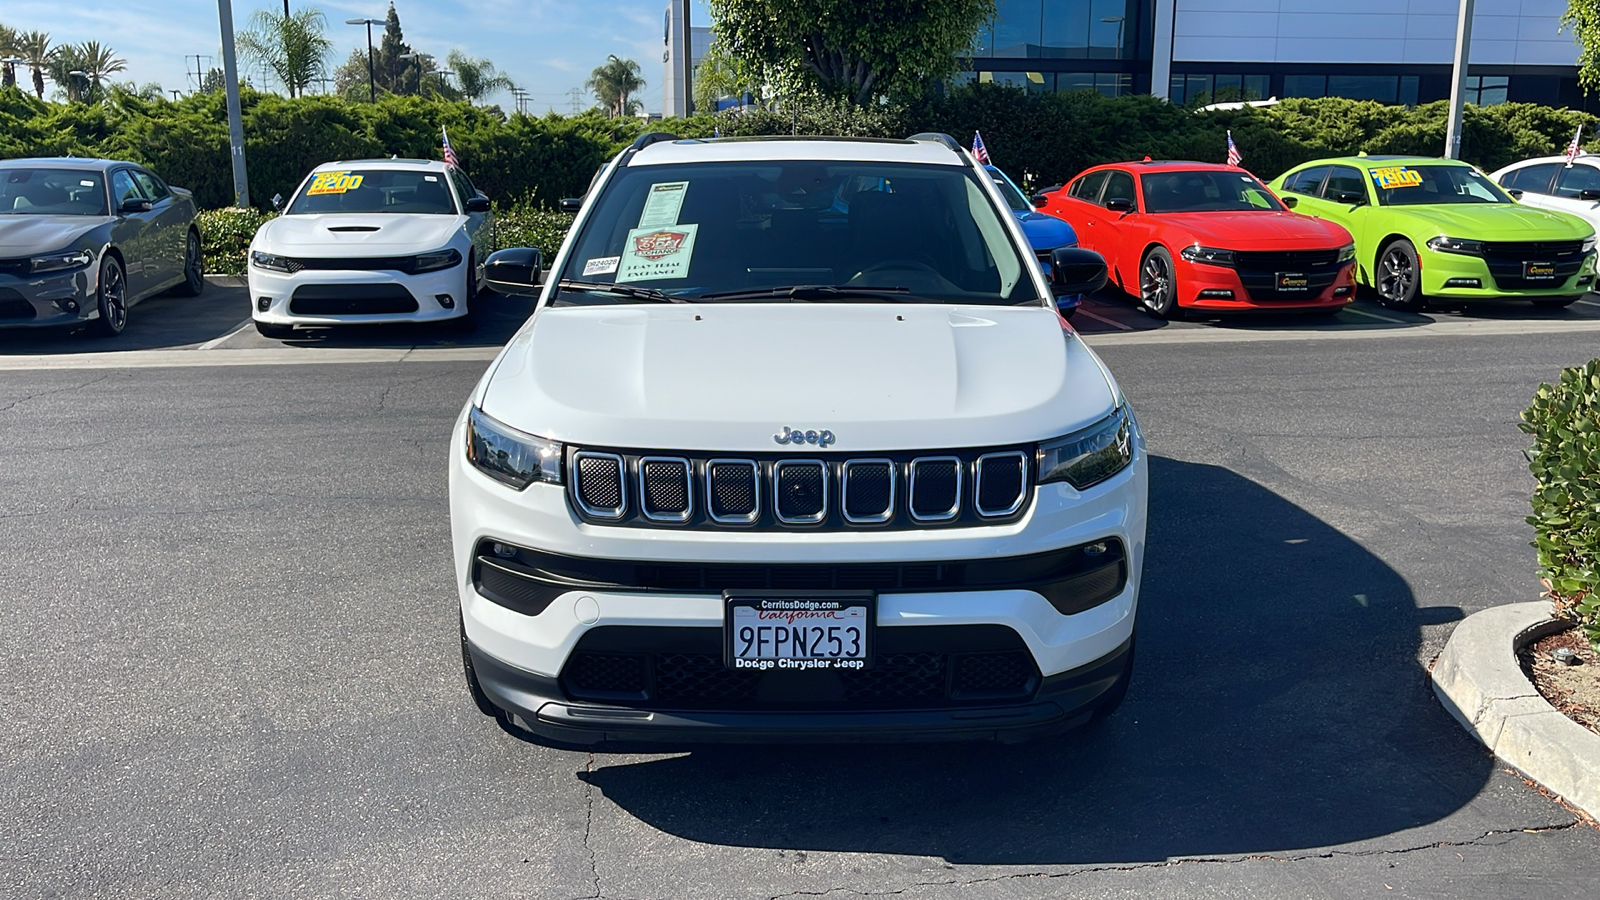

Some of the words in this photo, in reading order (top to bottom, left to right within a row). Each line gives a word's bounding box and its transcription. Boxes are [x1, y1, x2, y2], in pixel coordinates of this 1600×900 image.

[1452, 134, 1461, 144] 12
[231, 145, 242, 156] 11
[310, 175, 364, 190] 8200
[1372, 170, 1422, 184] 7900
[634, 247, 680, 256] EXCHANGE
[627, 269, 676, 278] EXCHANGE
[773, 426, 836, 448] Jeep
[761, 600, 839, 610] CerritosDodge.com
[758, 610, 845, 624] California
[739, 626, 861, 657] 9FPN253
[735, 658, 774, 670] Dodge
[778, 658, 831, 670] Chrysler
[833, 658, 864, 670] Jeep
